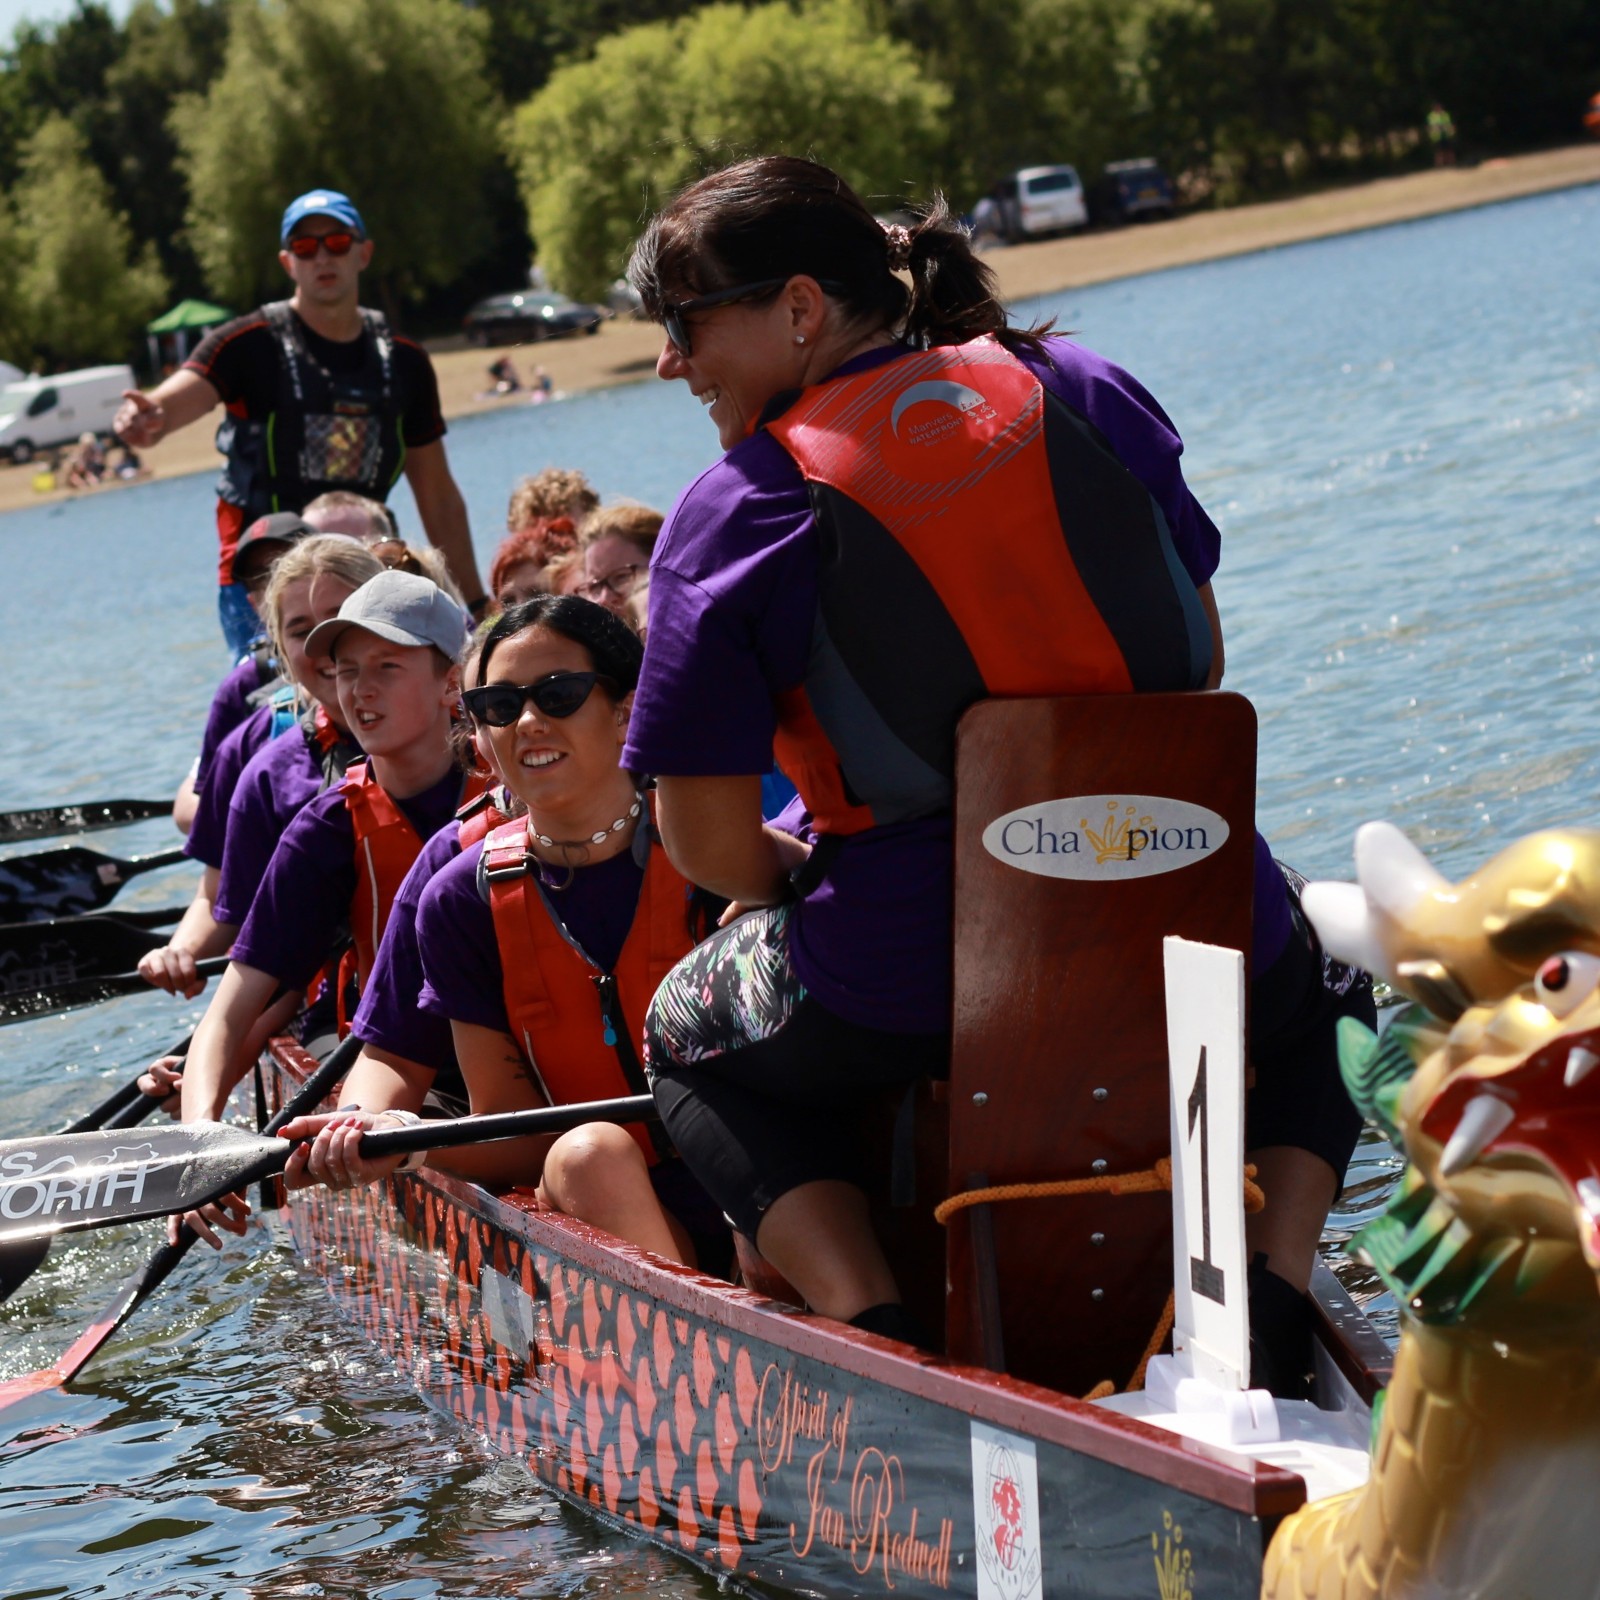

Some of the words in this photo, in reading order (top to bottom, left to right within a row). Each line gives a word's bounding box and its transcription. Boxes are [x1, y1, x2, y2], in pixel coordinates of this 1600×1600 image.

[908, 412, 953, 435] Manvers
[908, 416, 964, 446] WATERFRONT
[0, 1162, 148, 1219] ORTH
[1187, 1045, 1226, 1307] 1
[757, 1363, 829, 1474] Spirit
[832, 1396, 854, 1484] of
[851, 1446, 954, 1590] Rodwell
